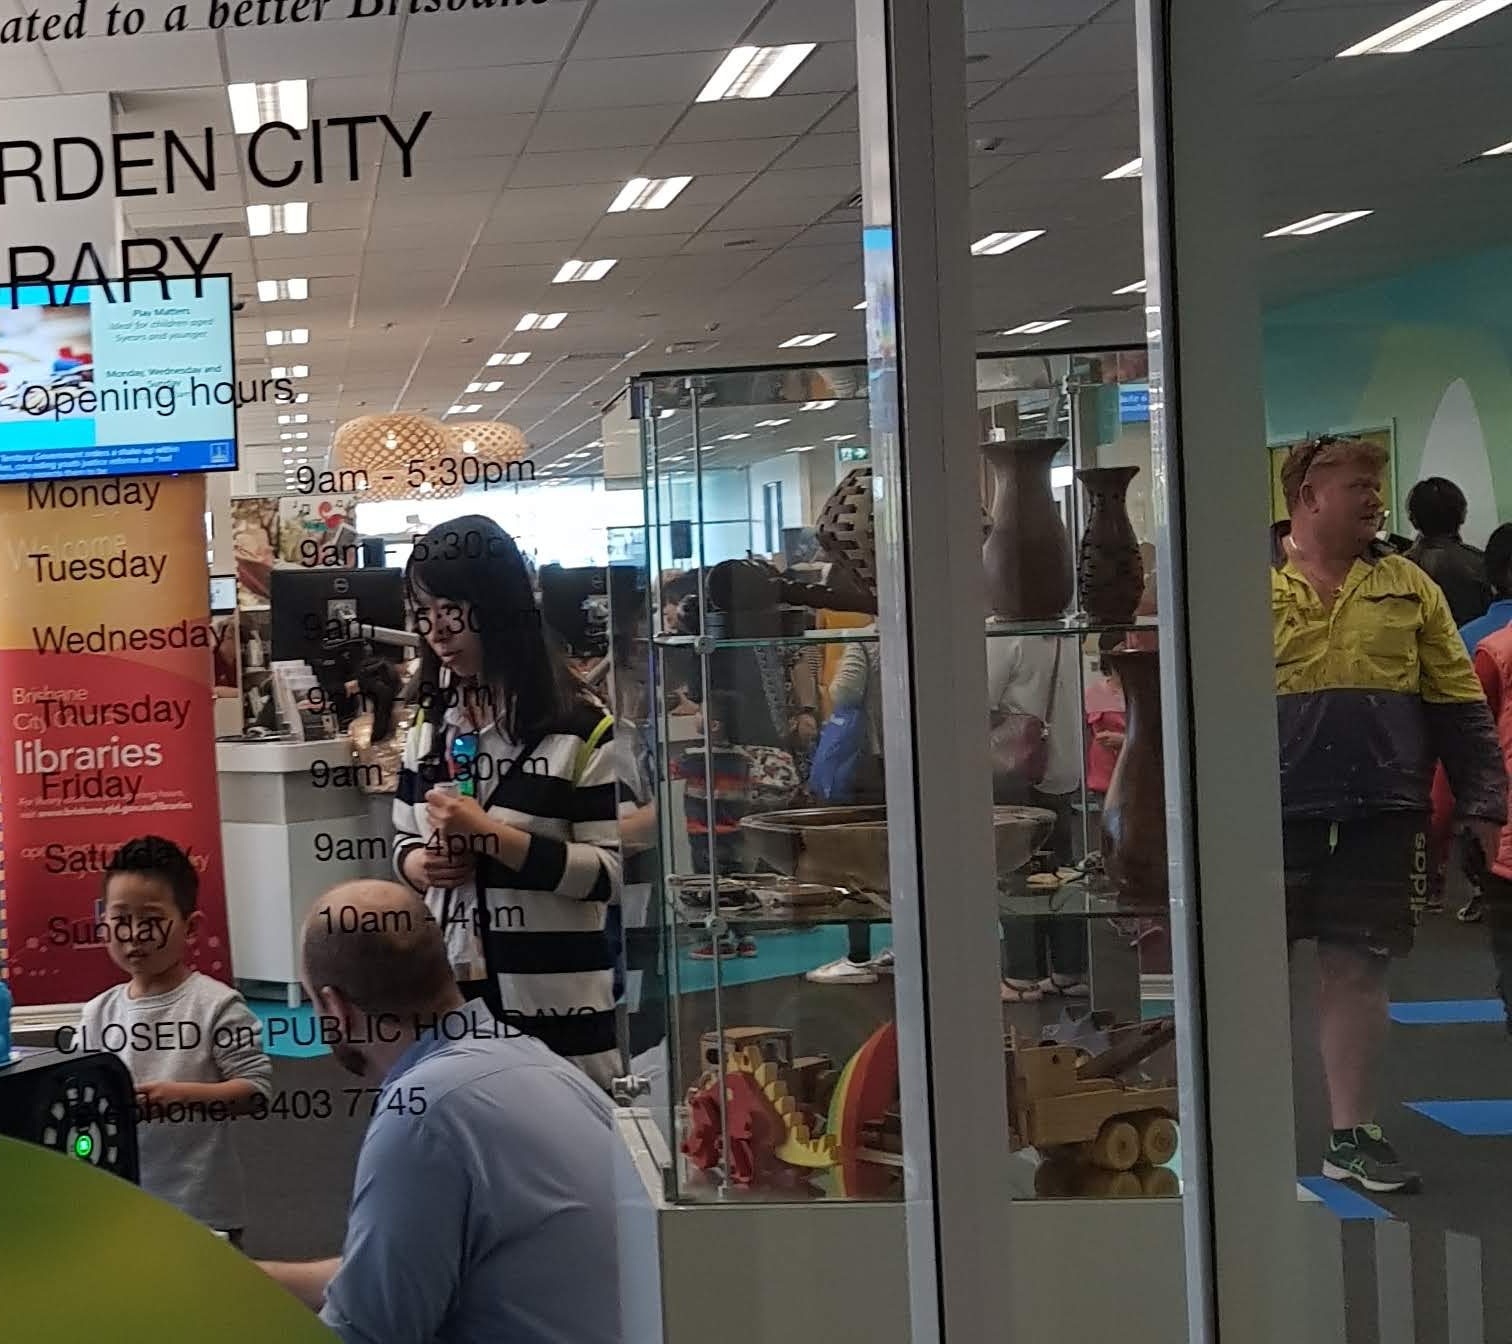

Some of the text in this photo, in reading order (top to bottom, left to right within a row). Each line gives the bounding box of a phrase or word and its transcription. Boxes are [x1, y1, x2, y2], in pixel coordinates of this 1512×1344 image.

[106, 3, 145, 37] to
[165, 7, 189, 33] a
[248, 111, 433, 188] CITY
[22, 376, 295, 422] Opening hours
[296, 466, 369, 495] 9am
[406, 455, 536, 491] 5:30pm
[27, 477, 161, 511] Monday
[8, 531, 128, 571] Welcome
[28, 549, 167, 584] Tuesday
[32, 619, 228, 656] Wednesday
[35, 693, 191, 730] Thursday
[14, 735, 163, 774] libraries
[40, 770, 143, 805] Friday
[311, 759, 383, 789] 9am
[314, 832, 387, 862] 9am
[424, 828, 500, 860] 4pm
[1408, 831, 1428, 931] didas
[48, 911, 174, 949] Sunday
[319, 905, 413, 935] 10am
[55, 1021, 202, 1056] CLOSED
[214, 1026, 257, 1050] on
[266, 1011, 401, 1049] PUBLIC
[253, 1088, 333, 1120] 3403
[348, 1086, 427, 1117] 7745
